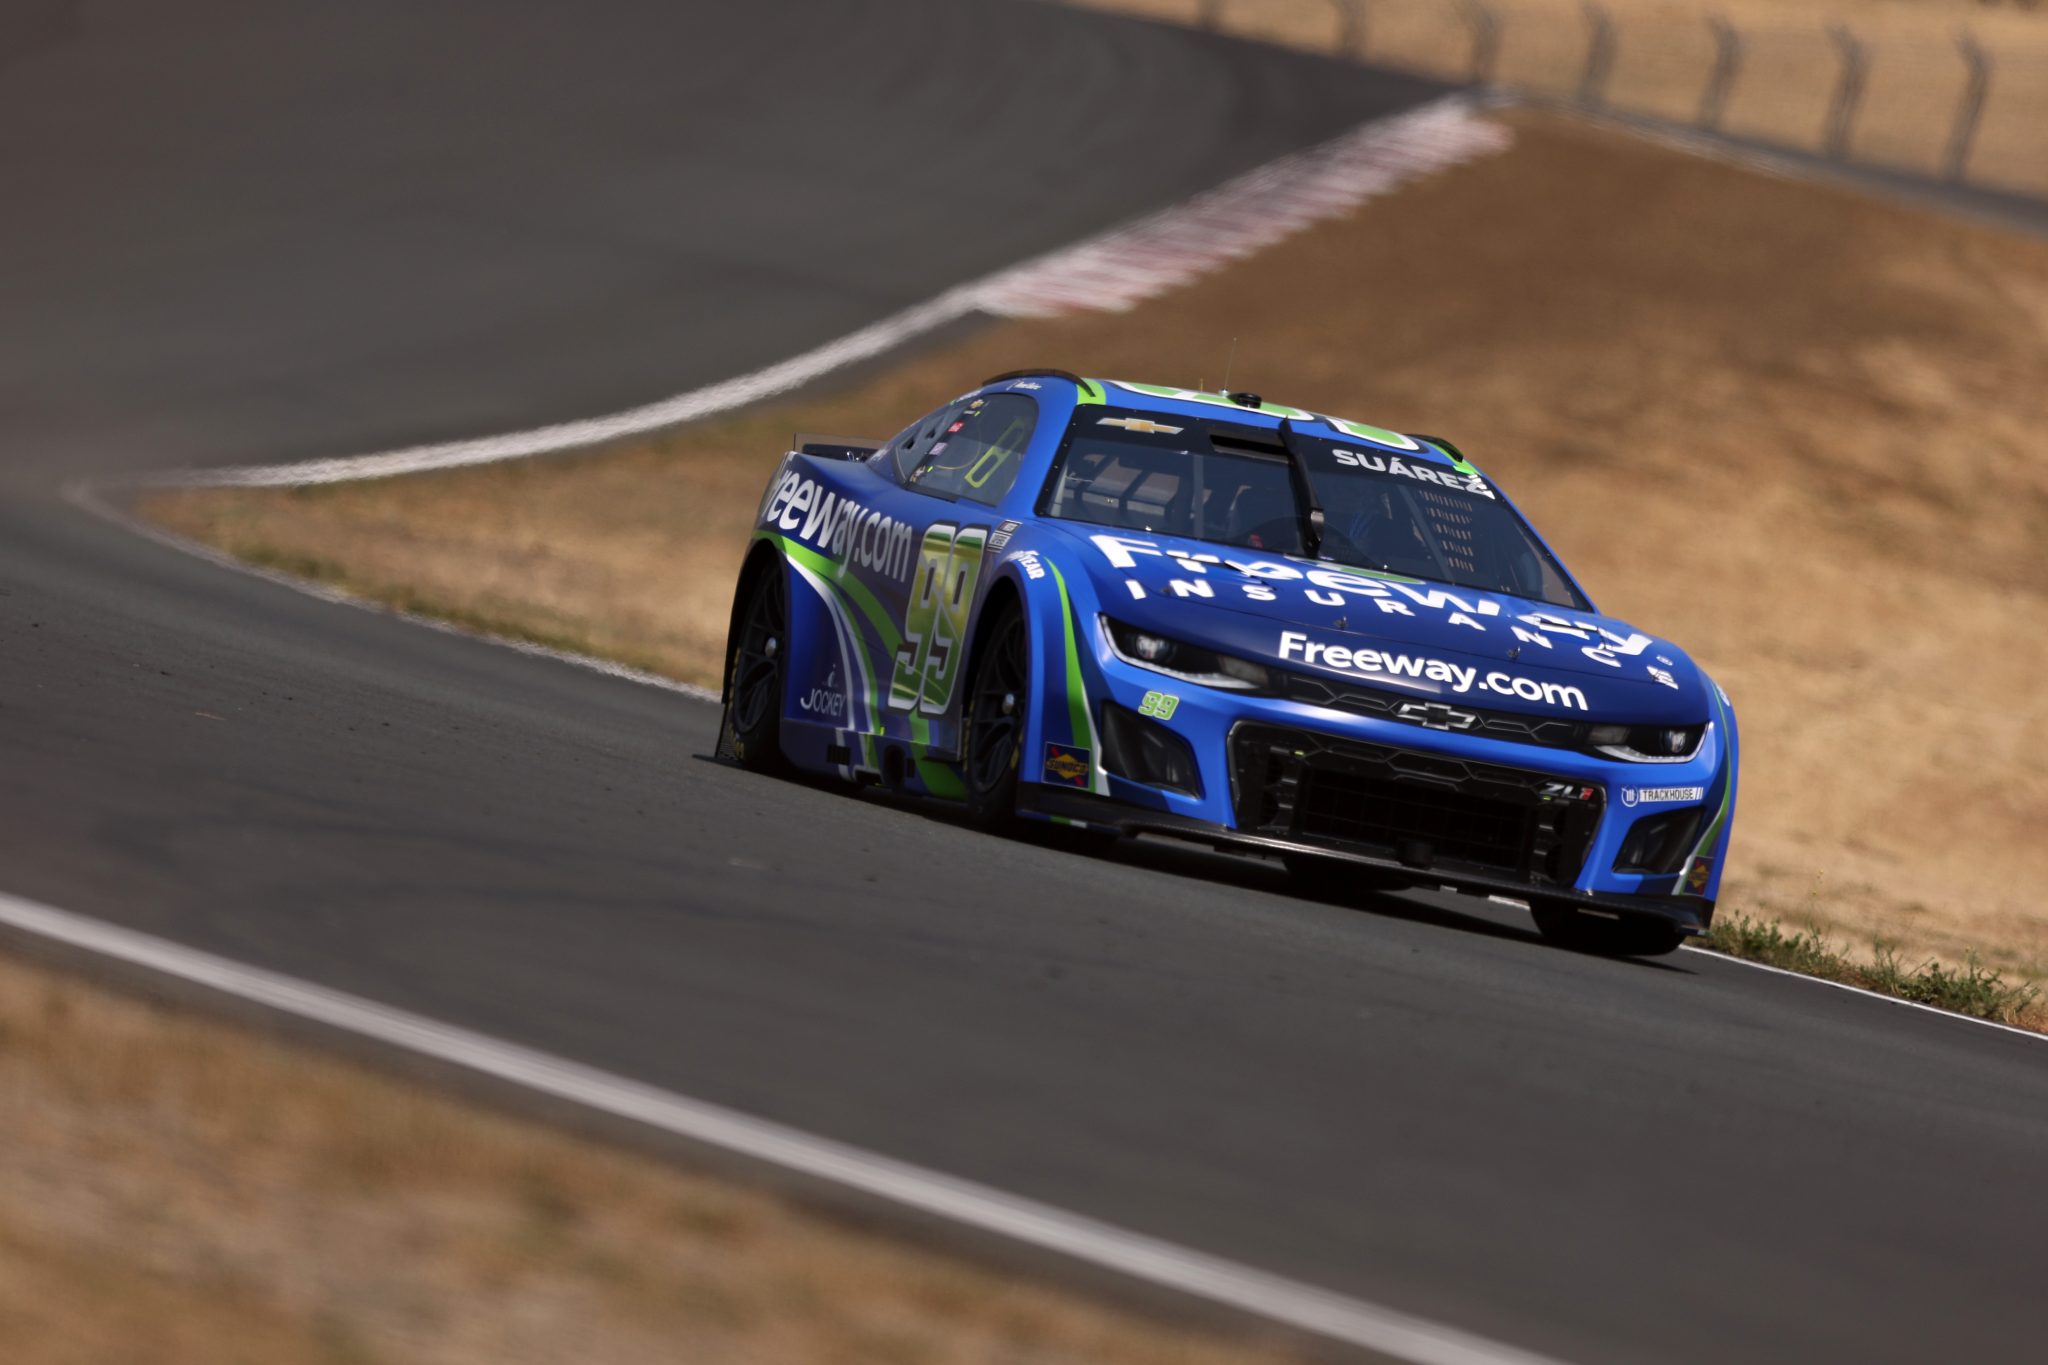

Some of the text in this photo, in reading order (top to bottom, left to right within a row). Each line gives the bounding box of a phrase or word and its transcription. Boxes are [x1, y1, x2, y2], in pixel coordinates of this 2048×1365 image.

[1332, 449, 1494, 499] SUÁREZ
[762, 470, 912, 582] reeway.com
[1004, 551, 1046, 581] YEAR
[1089, 534, 1653, 656] Freeway
[888, 523, 988, 715] 99
[1125, 578, 1680, 691] INSURANCE
[800, 687, 847, 718] JOCKEY
[1278, 630, 1590, 711] Freeway.com
[1138, 690, 1180, 721] 99
[1643, 789, 1695, 801] TRACKHOUSE
